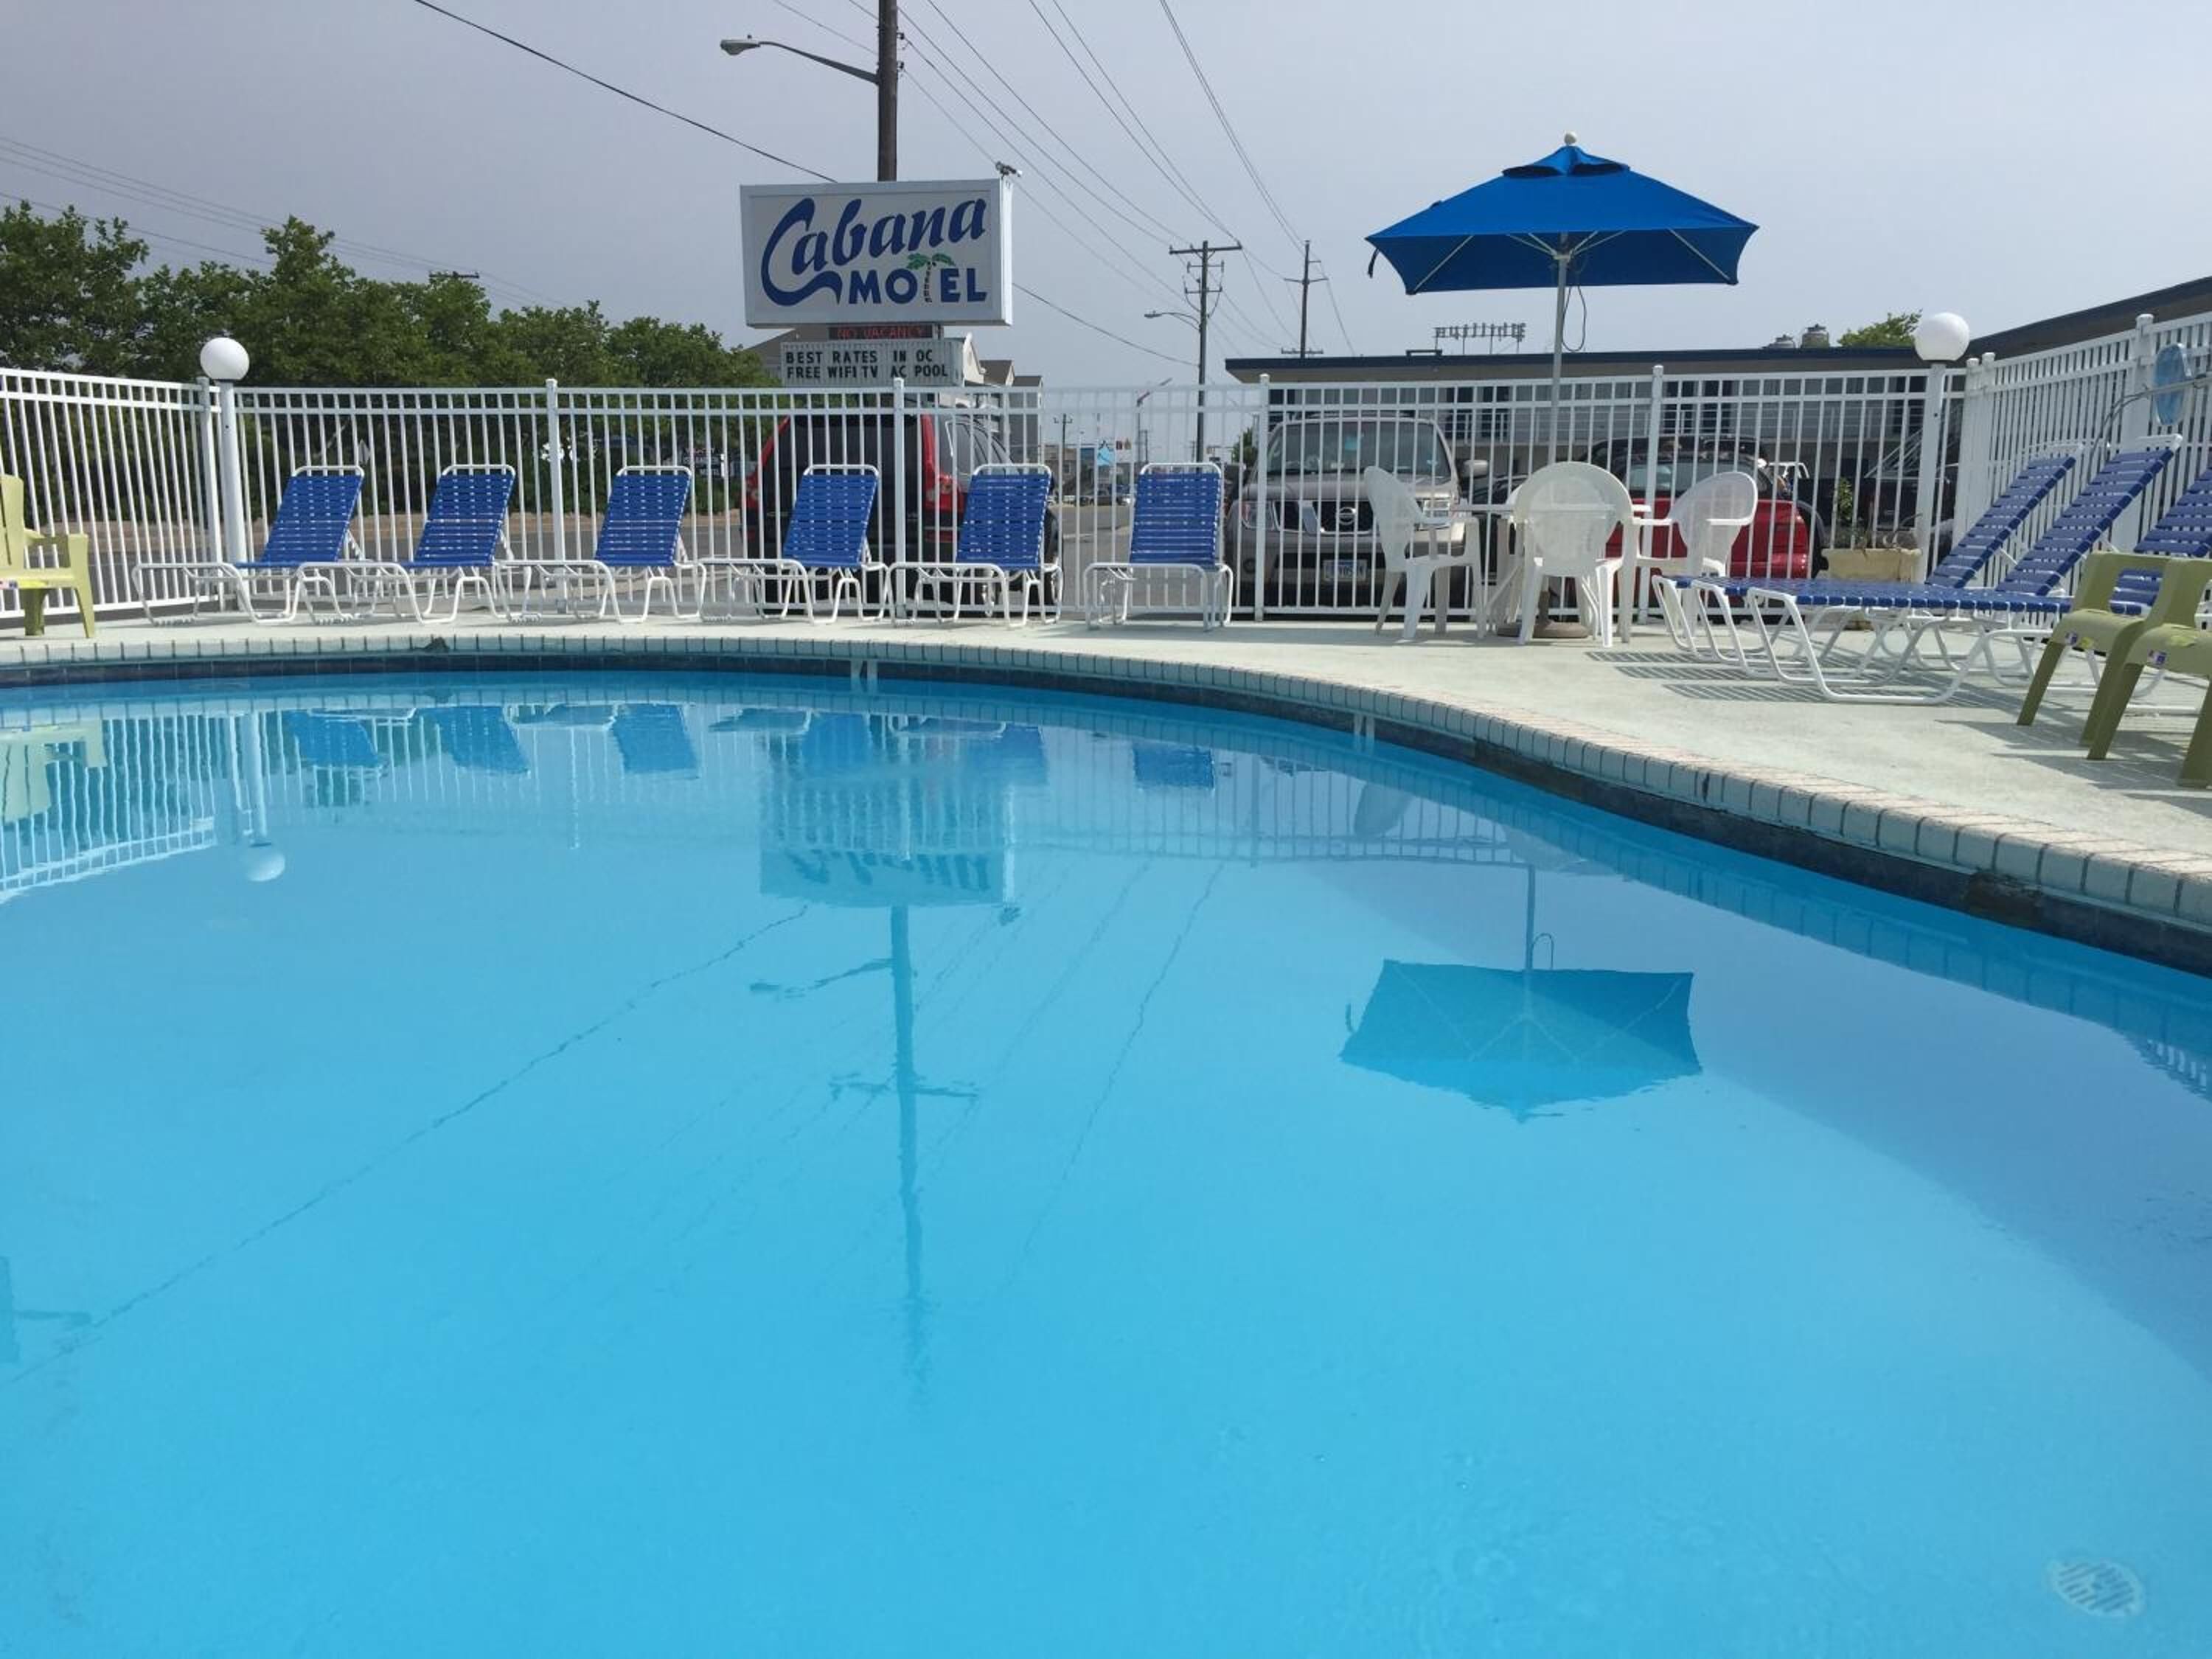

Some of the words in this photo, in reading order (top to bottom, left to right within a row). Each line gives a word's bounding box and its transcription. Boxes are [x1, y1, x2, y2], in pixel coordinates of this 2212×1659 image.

[761, 197, 987, 307] Cabana
[849, 254, 987, 305] MOTEL
[785, 351, 823, 364] BEST
[832, 350, 878, 364] RATES
[893, 349, 906, 363] IN
[916, 349, 933, 362] OC
[787, 366, 821, 379] FREE
[827, 366, 856, 378] WIFI
[862, 366, 879, 378] TV
[890, 365, 907, 378] AC
[914, 364, 949, 378] POOL
